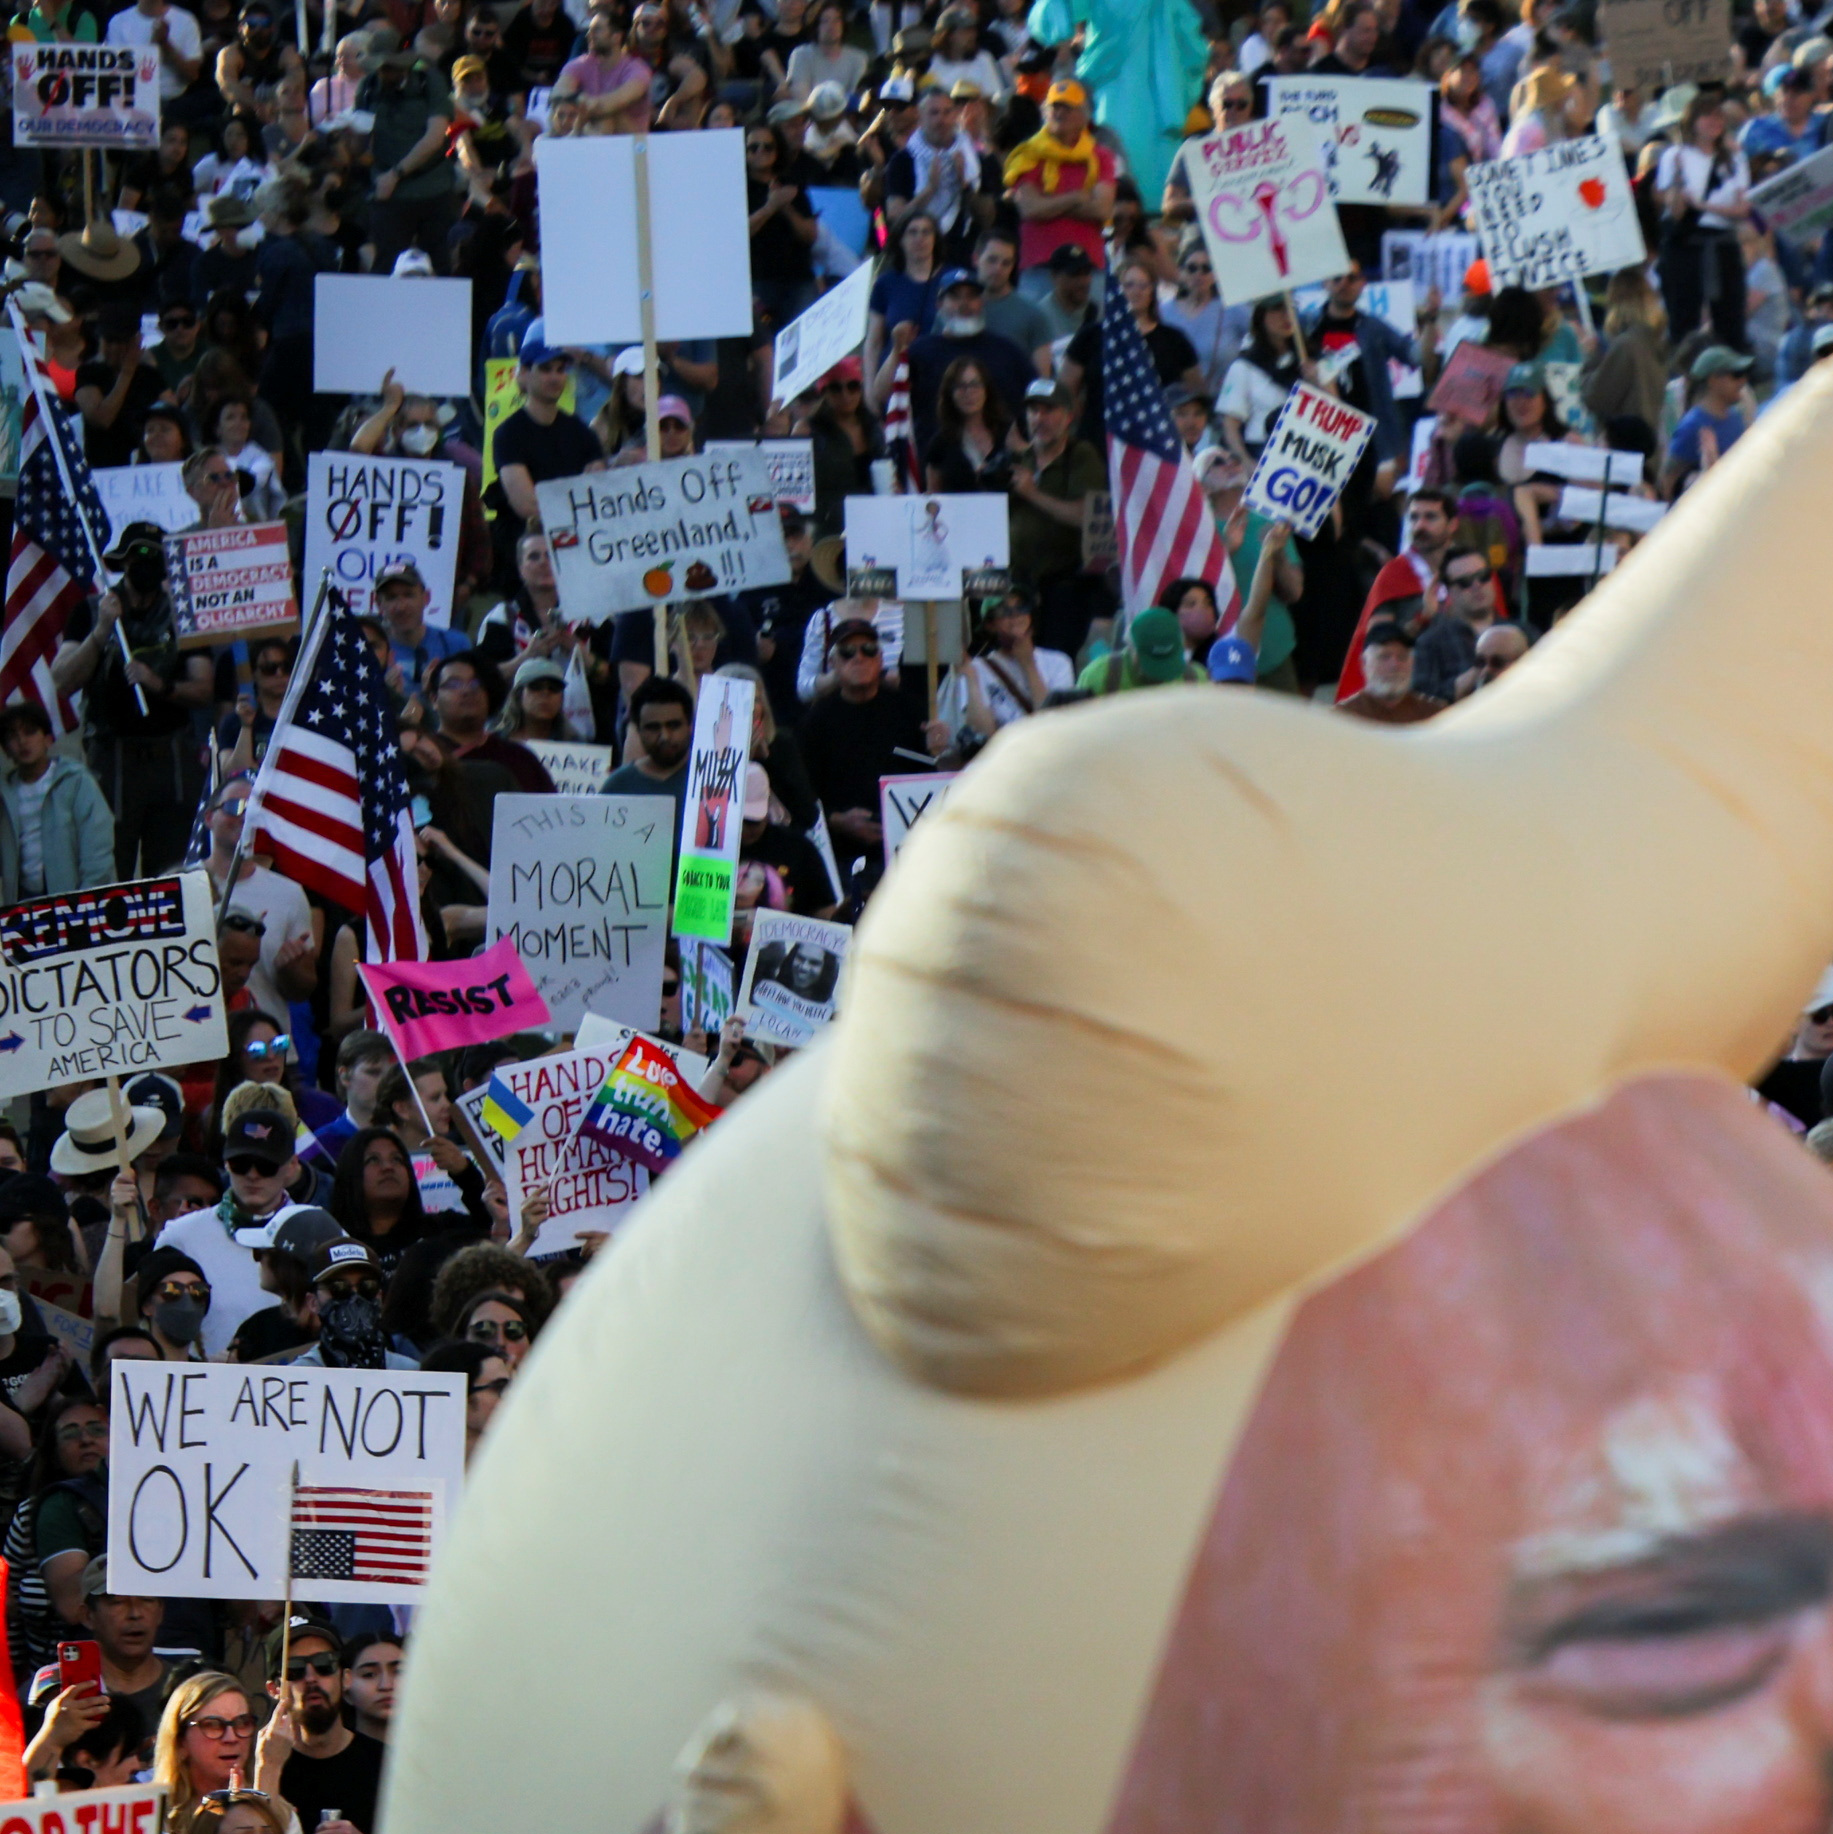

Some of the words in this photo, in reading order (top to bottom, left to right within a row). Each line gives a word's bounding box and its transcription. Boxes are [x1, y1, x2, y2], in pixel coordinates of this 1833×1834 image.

[38, 50, 135, 69] HANDS
[1296, 389, 1363, 442] TRUMP
[1280, 430, 1345, 479] MUSK
[328, 464, 444, 505] HANDS
[569, 476, 665, 525] Hands
[681, 461, 742, 503] Off
[1266, 467, 1334, 523] GO!
[186, 530, 257, 551] AMERICA
[189, 557, 205, 571] IS
[207, 555, 218, 569] A
[191, 564, 289, 592] DEMOCRACY
[196, 591, 229, 610] NOT
[232, 588, 254, 607] AN
[196, 604, 286, 629] OLIGARCHY
[511, 857, 663, 916] MORAL
[0, 882, 184, 957] REMOVE
[496, 918, 647, 967] MOMENT
[384, 972, 517, 1023] RESIST
[30, 1012, 76, 1050] TO
[89, 999, 182, 1046] SAVE
[48, 1042, 161, 1080] AMERICA
[121, 1373, 207, 1453] WE
[230, 1377, 309, 1432] ARE
[320, 1385, 451, 1460] NOT
[127, 1463, 259, 1580] OK
